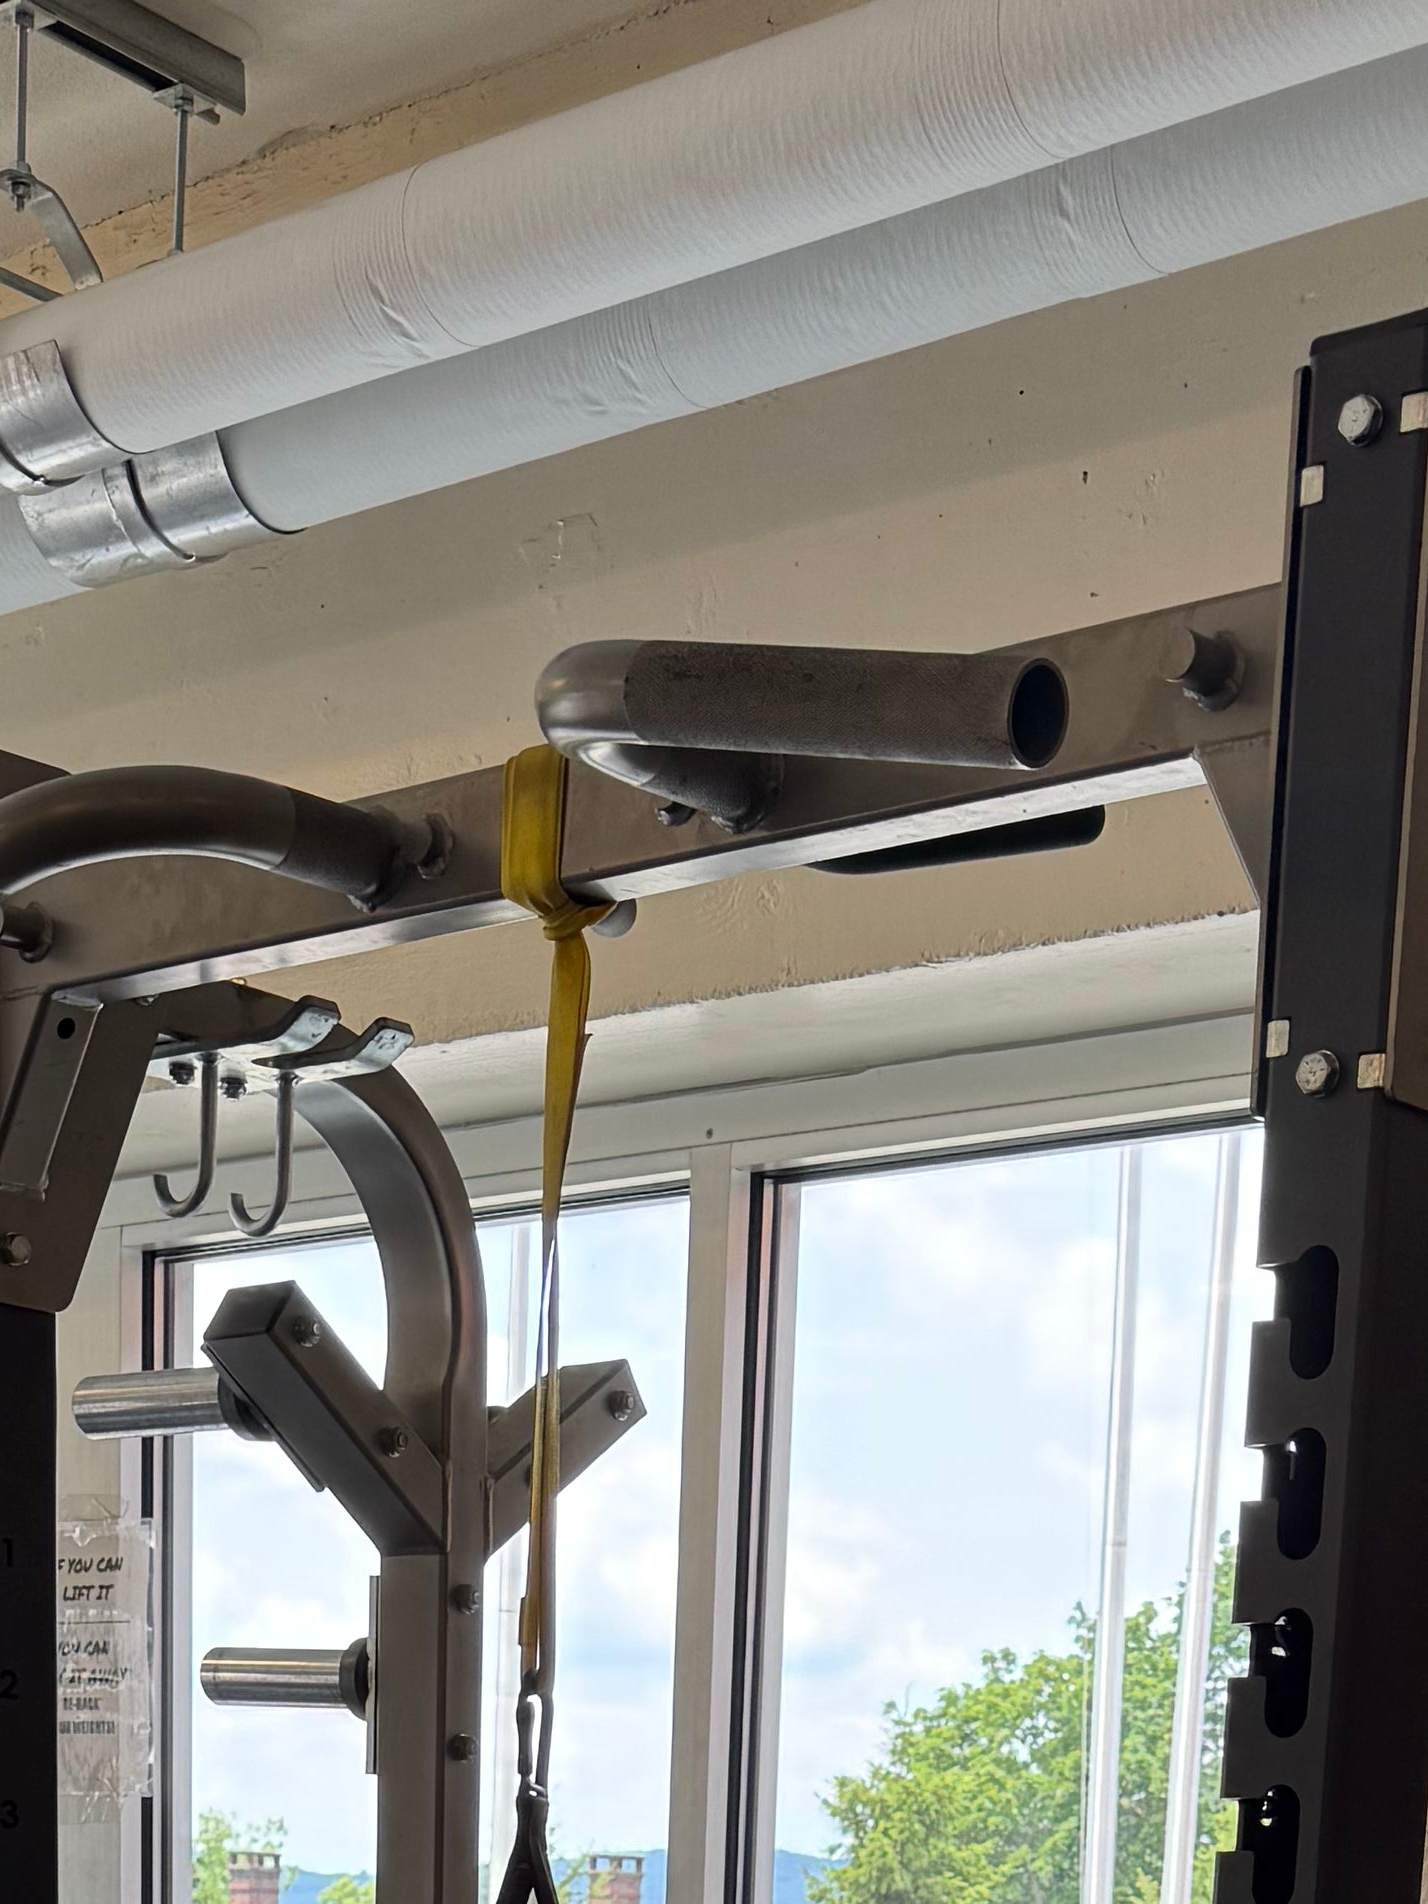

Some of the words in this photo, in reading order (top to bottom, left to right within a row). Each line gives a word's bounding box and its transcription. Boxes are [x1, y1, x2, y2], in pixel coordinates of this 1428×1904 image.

[2, 1537, 14, 1567] 1
[67, 1557, 93, 1574] YOU
[96, 1556, 123, 1573] CAN
[63, 1584, 94, 1602] LIFT
[96, 1584, 114, 1601] IT
[0, 1799, 19, 1829] 3
